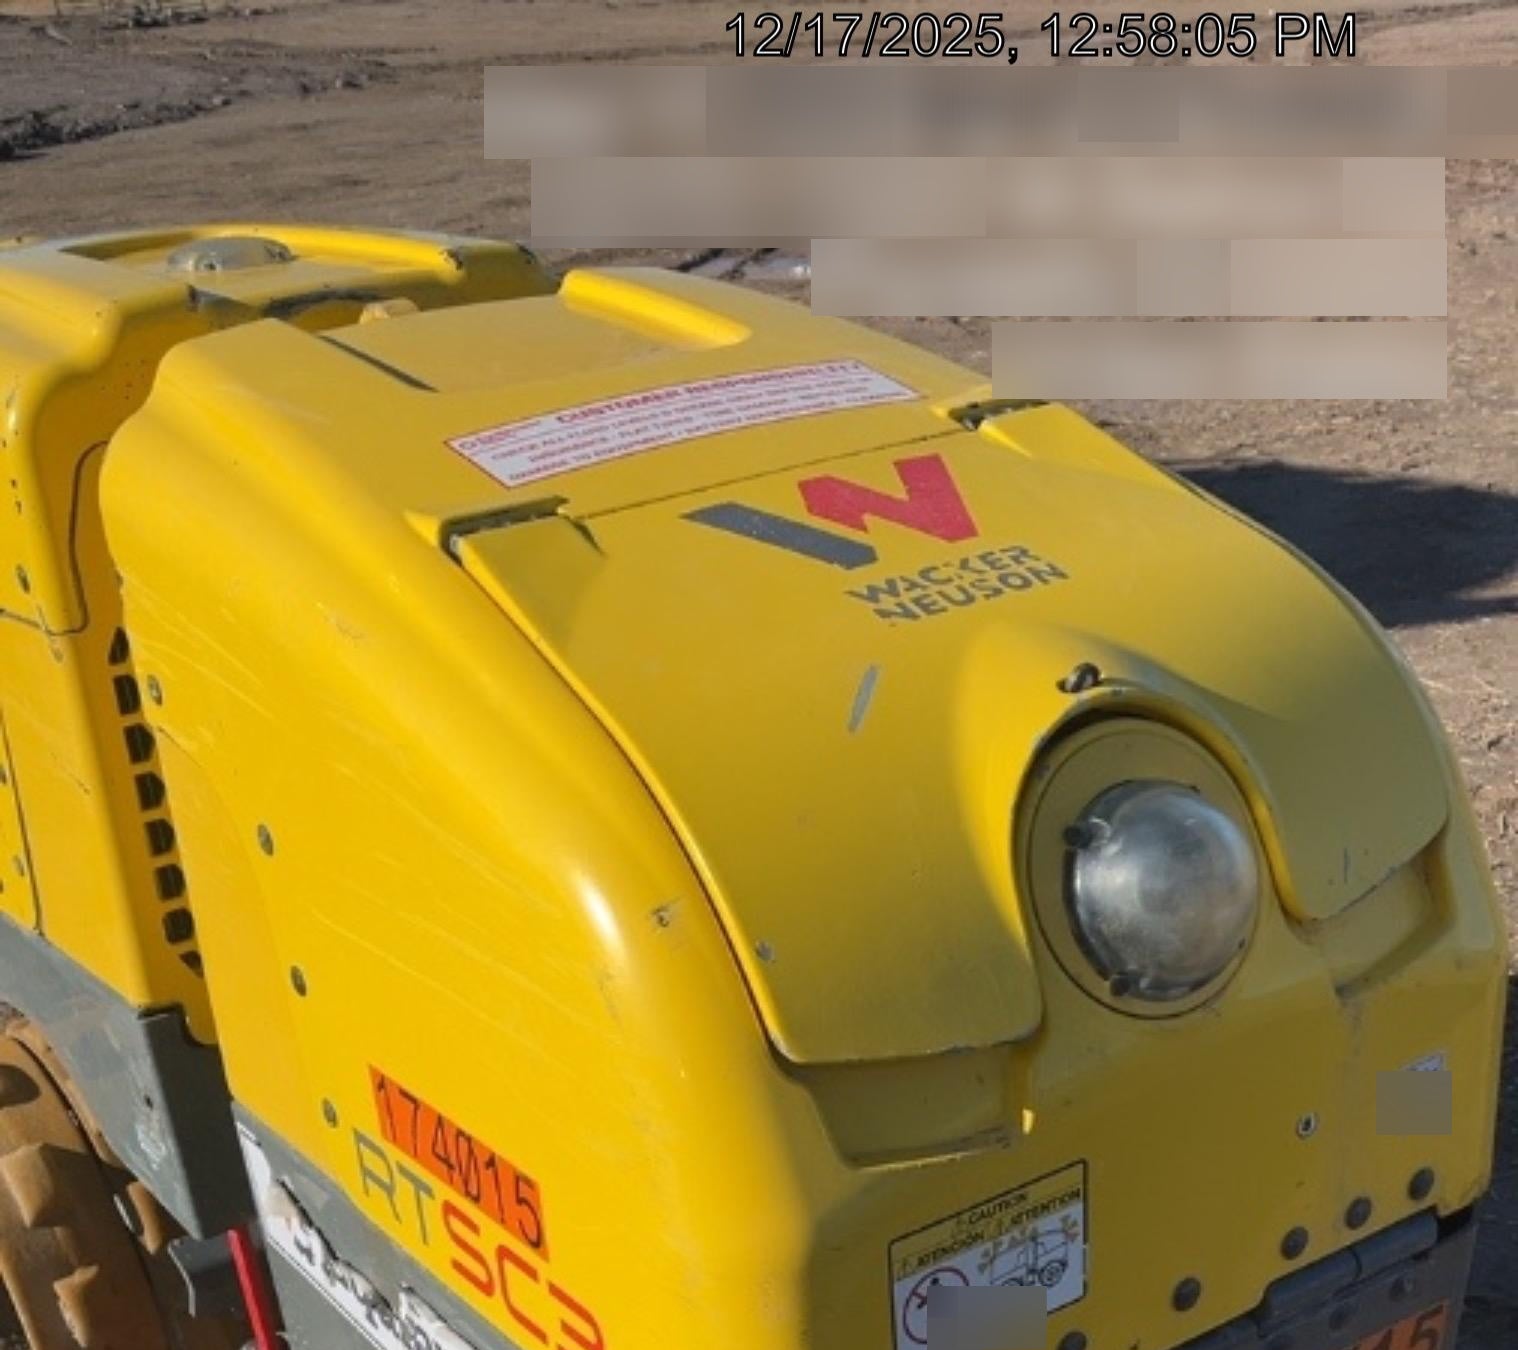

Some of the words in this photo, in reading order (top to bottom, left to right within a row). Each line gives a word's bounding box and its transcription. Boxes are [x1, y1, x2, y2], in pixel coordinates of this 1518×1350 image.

[556, 386, 682, 423] CUSTOMER
[843, 545, 1041, 604] WACKER
[872, 562, 1069, 621] NEUSON
[376, 1073, 541, 1251] 174015
[968, 1191, 1029, 1225] CAUTION
